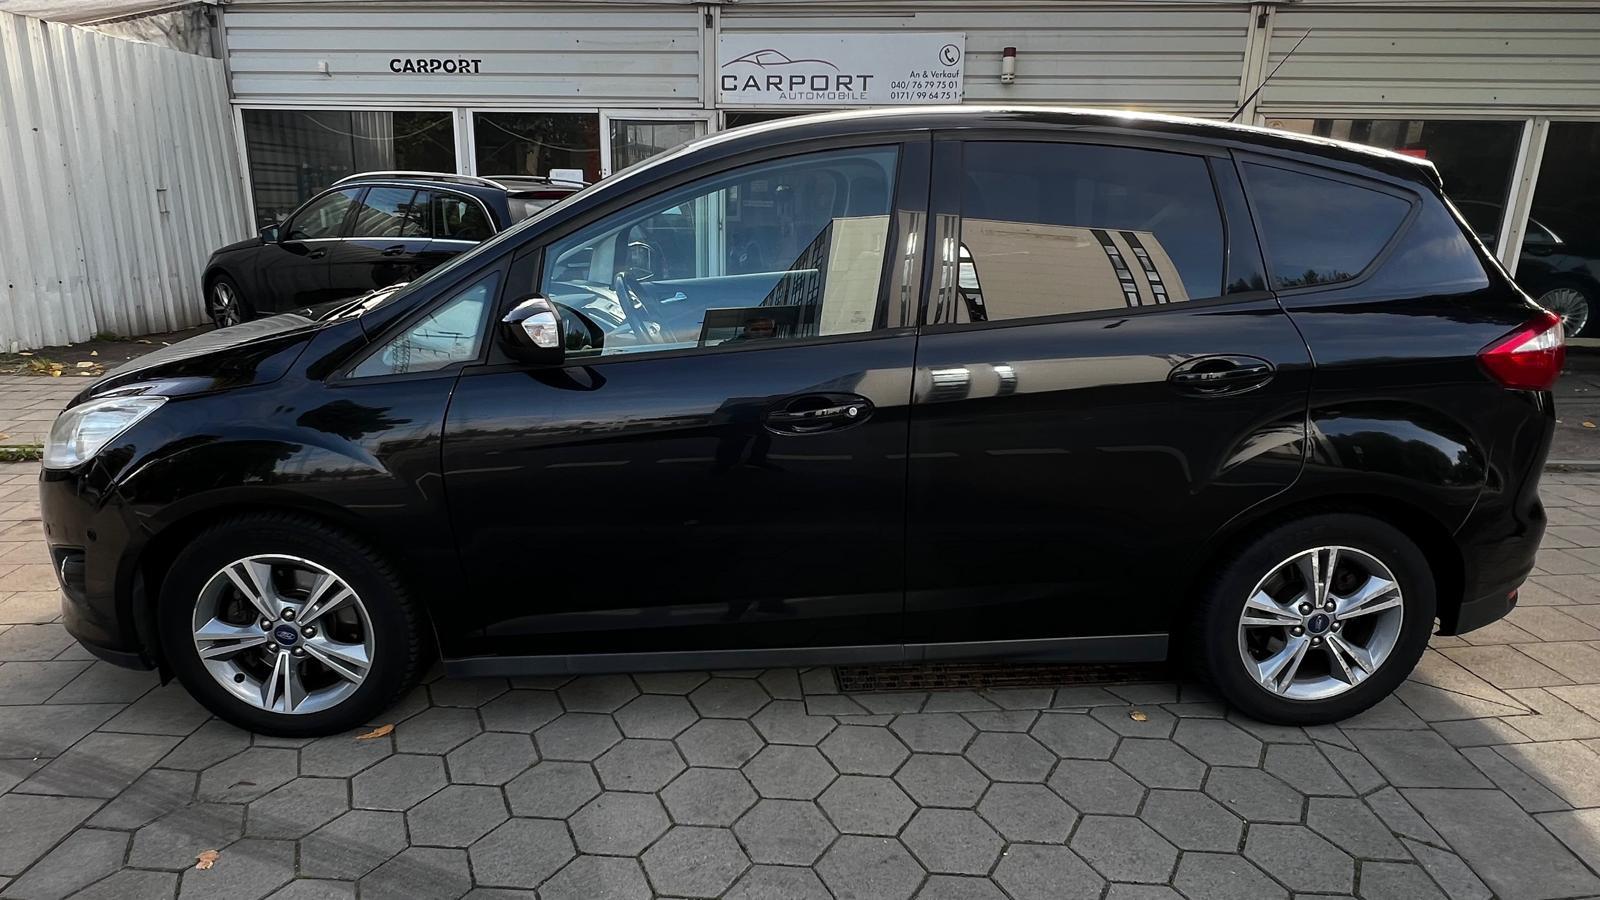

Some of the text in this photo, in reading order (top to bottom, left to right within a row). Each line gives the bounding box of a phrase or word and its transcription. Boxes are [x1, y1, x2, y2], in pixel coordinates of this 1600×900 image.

[389, 58, 482, 74] CARPORT
[910, 69, 960, 78] An & Verkauf
[721, 75, 874, 91] CARPORT
[890, 81, 958, 90] 040/ 76 79 75 01
[890, 91, 915, 101] 0171/
[916, 91, 927, 100] 99
[928, 91, 939, 100] 64
[941, 91, 951, 100] 75
